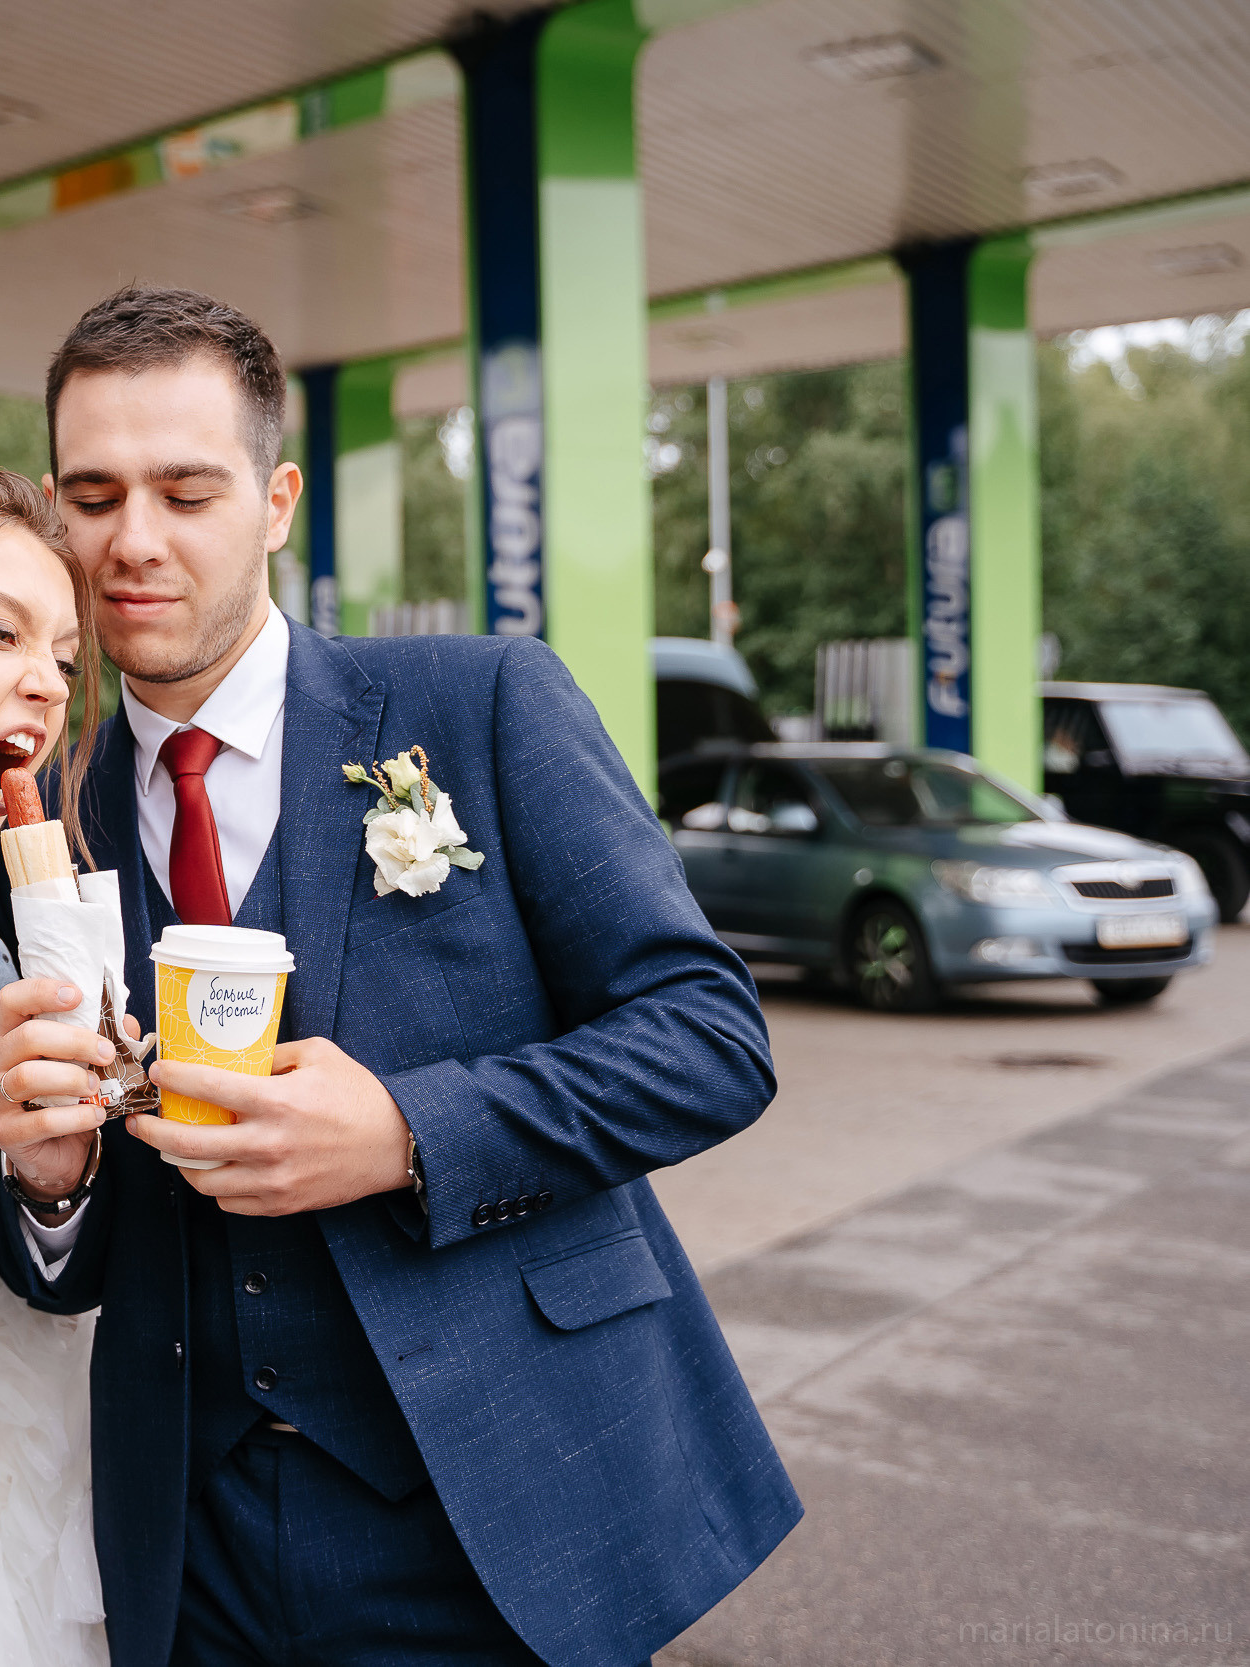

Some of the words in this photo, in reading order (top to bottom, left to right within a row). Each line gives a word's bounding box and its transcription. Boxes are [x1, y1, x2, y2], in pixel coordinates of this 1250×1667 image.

[489, 415, 542, 636] utura
[209, 976, 258, 1003] больше
[199, 997, 265, 1027] радости!
